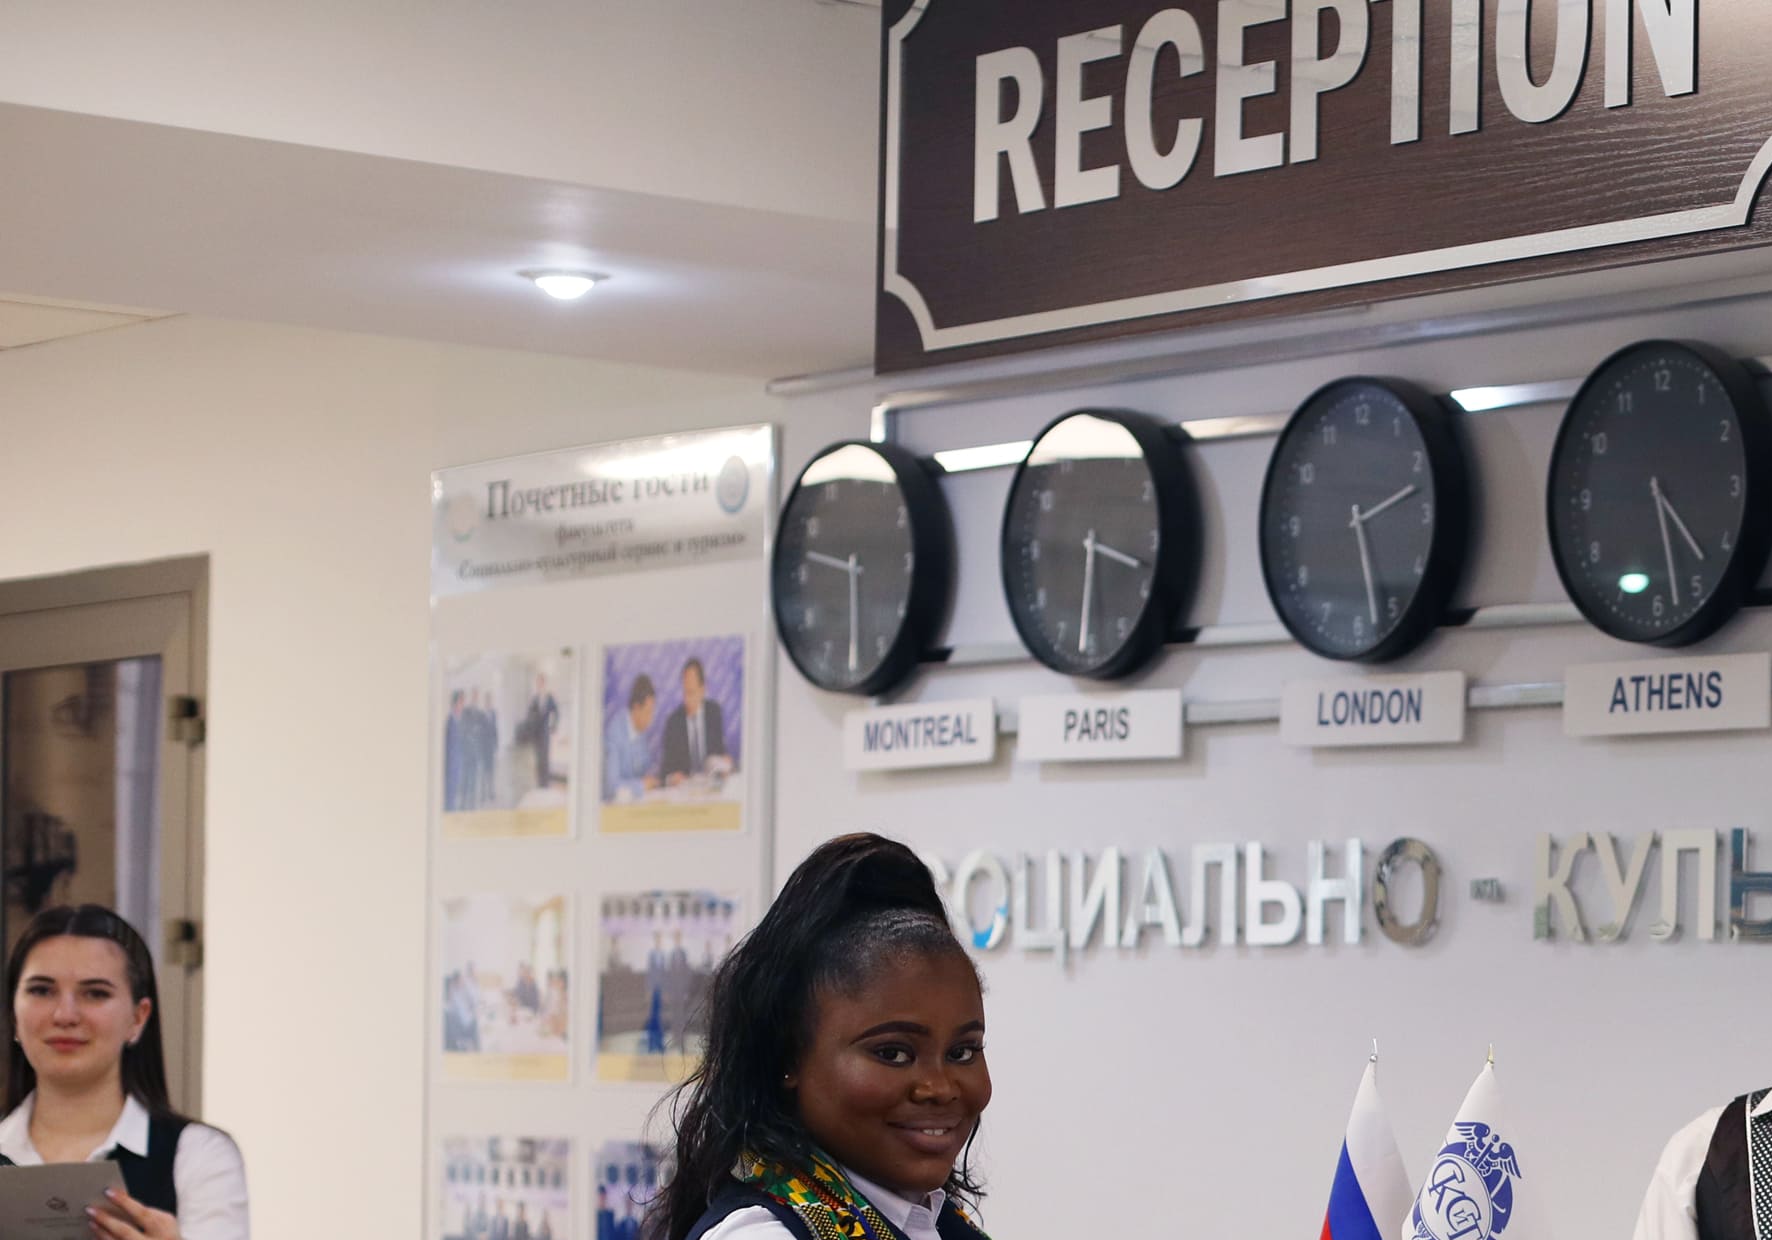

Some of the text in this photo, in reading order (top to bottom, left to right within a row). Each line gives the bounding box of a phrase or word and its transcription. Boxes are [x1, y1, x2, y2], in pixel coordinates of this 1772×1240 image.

[974, 0, 1698, 224] RECEPTION
[1653, 369, 1671, 392] 12
[1617, 392, 1632, 413] 11
[1698, 385, 1705, 405] 1
[1719, 420, 1730, 442] 2
[1590, 432, 1608, 455] 10
[1730, 474, 1741, 497] 3
[1580, 489, 1592, 511] 9
[1589, 541, 1600, 563] 8
[1720, 531, 1731, 551] 4
[1690, 574, 1702, 597] 5
[1652, 595, 1664, 617] 6
[1609, 671, 1723, 713] ATHENS
[1317, 689, 1422, 726] LONDON
[863, 717, 978, 753] MONTREAL
[1064, 708, 1130, 743] PARIS
[920, 836, 1441, 974] ОЦИАЛЬНО
